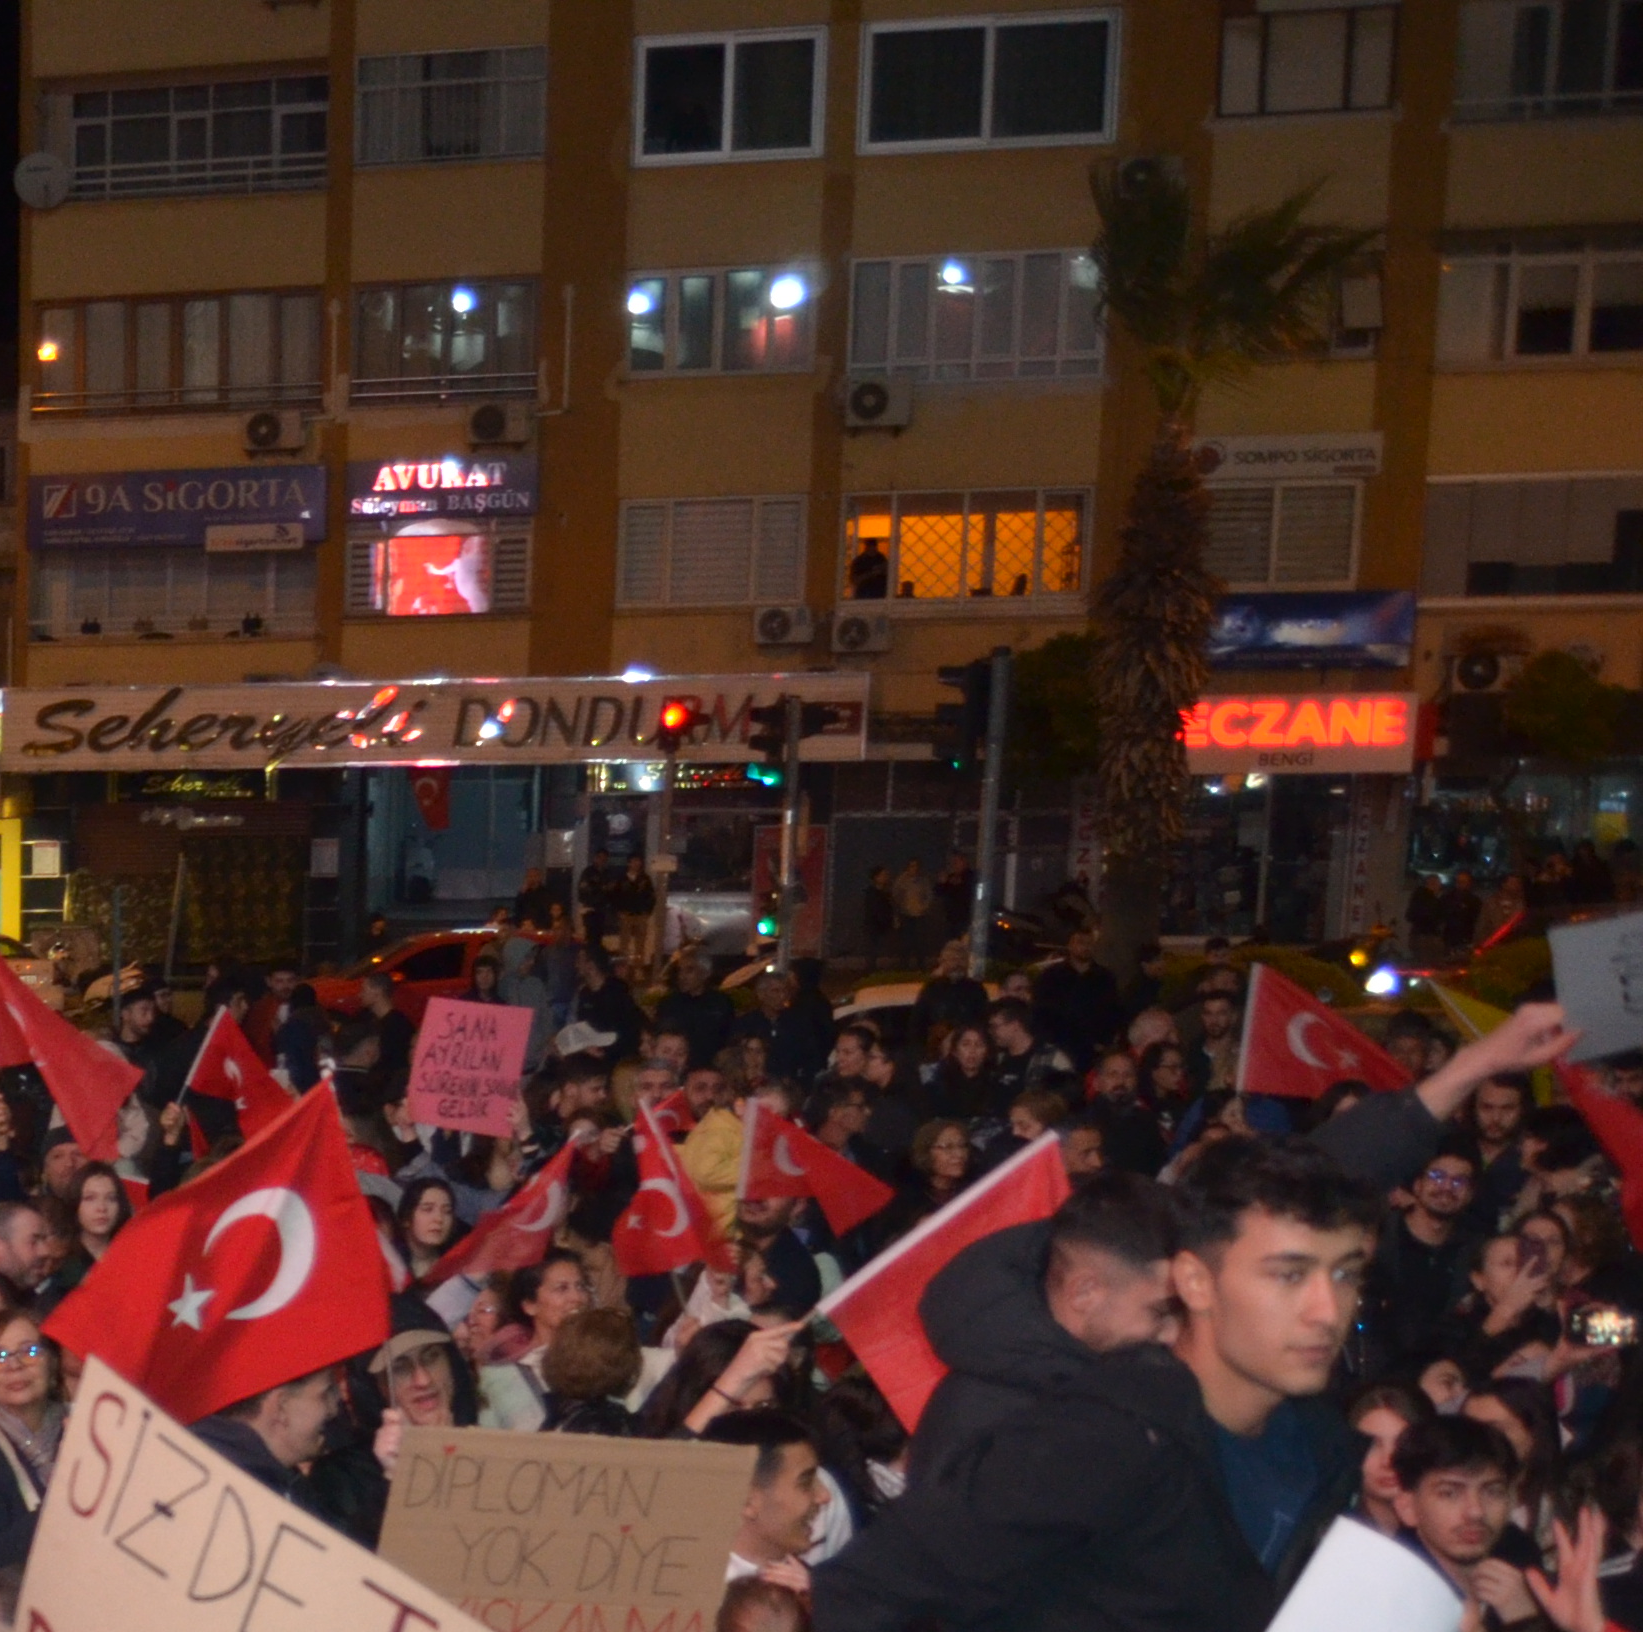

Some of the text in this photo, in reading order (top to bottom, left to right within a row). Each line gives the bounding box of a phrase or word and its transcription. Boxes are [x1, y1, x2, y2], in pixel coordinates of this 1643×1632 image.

[1234, 450, 1297, 465] SOMPO
[372, 461, 507, 491] AVUKAT
[85, 485, 133, 514] 9A
[350, 489, 530, 516] Süleyman BAŞGÜN
[402, 1444, 662, 1520] DİPLOMAN
[453, 1523, 700, 1600] YOK DİYE
